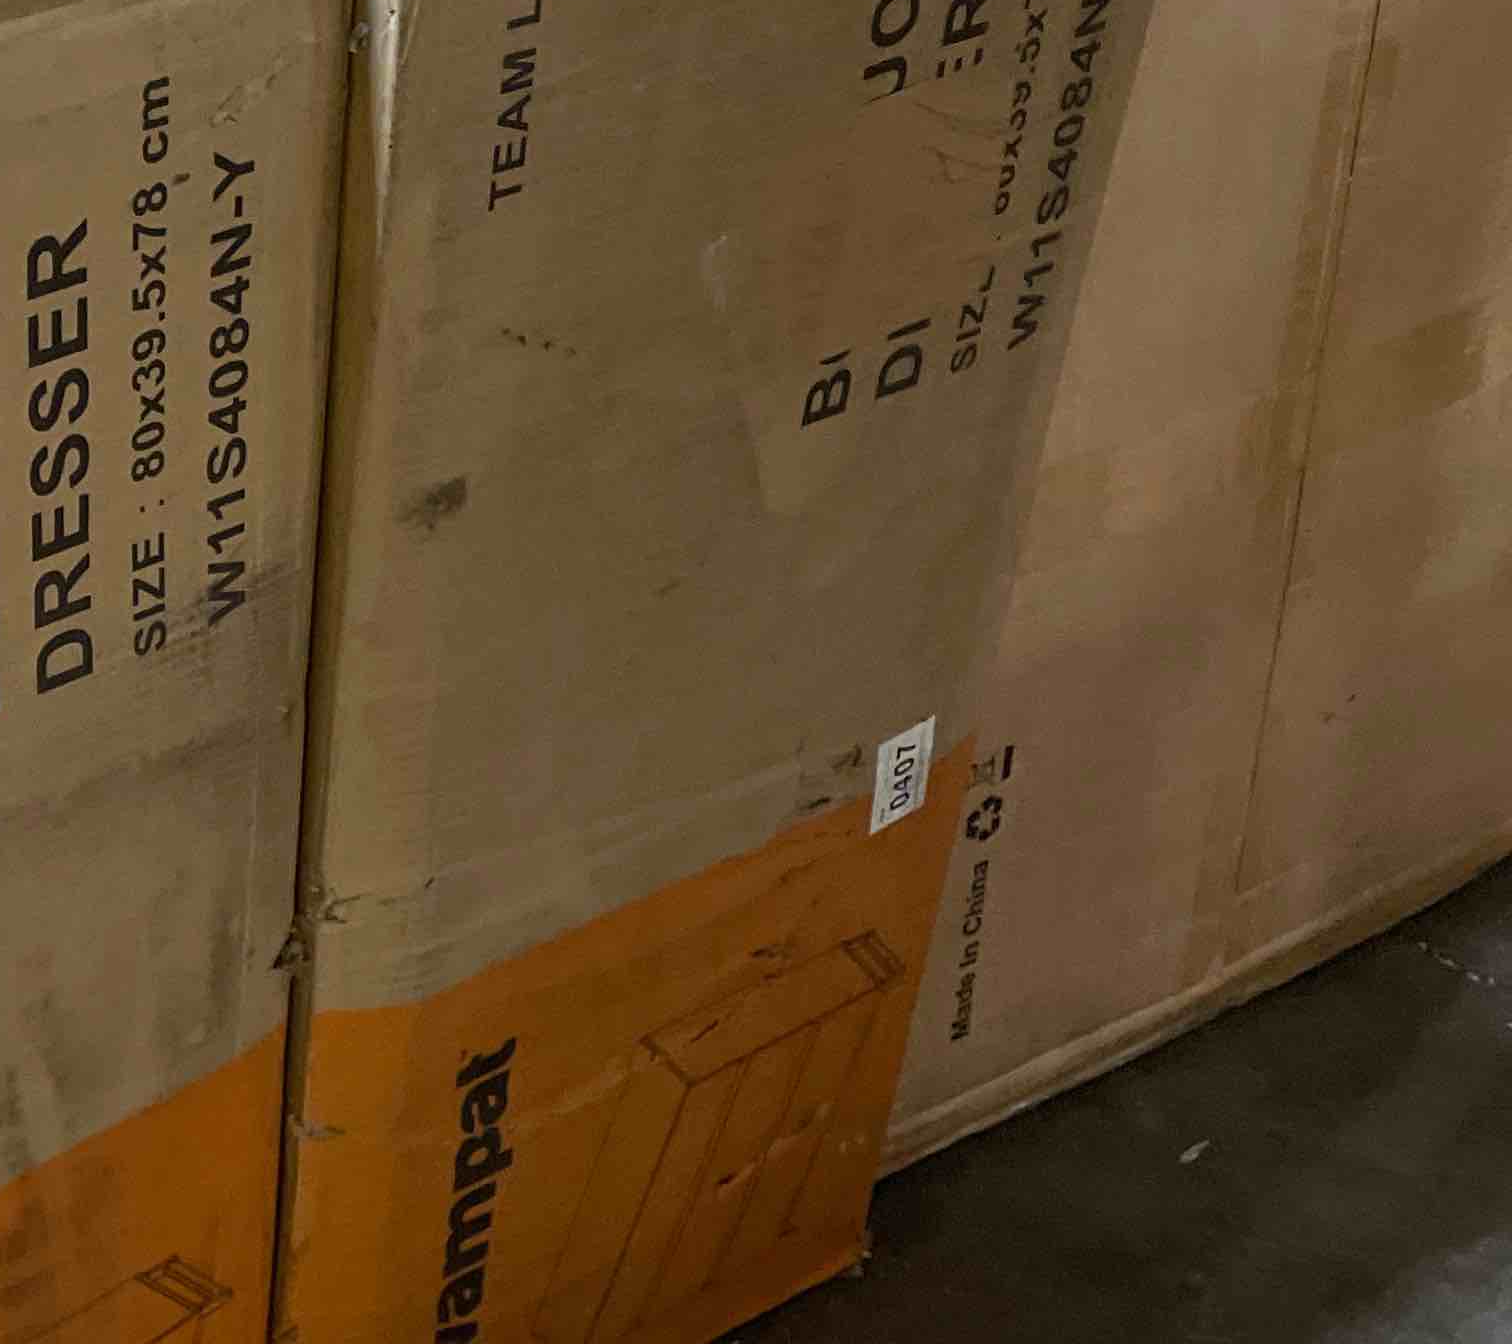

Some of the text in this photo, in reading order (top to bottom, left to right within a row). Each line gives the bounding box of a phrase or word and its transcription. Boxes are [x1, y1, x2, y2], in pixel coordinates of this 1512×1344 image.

[141, 75, 170, 164] cm
[488, 46, 538, 213] TEAM
[131, 181, 168, 484] 80x39.5x78
[205, 150, 256, 627] W11S4084N-Y
[26, 216, 94, 696] DRESSER
[132, 530, 167, 657] SIZE
[962, 859, 990, 937] China
[949, 973, 977, 1042] Made
